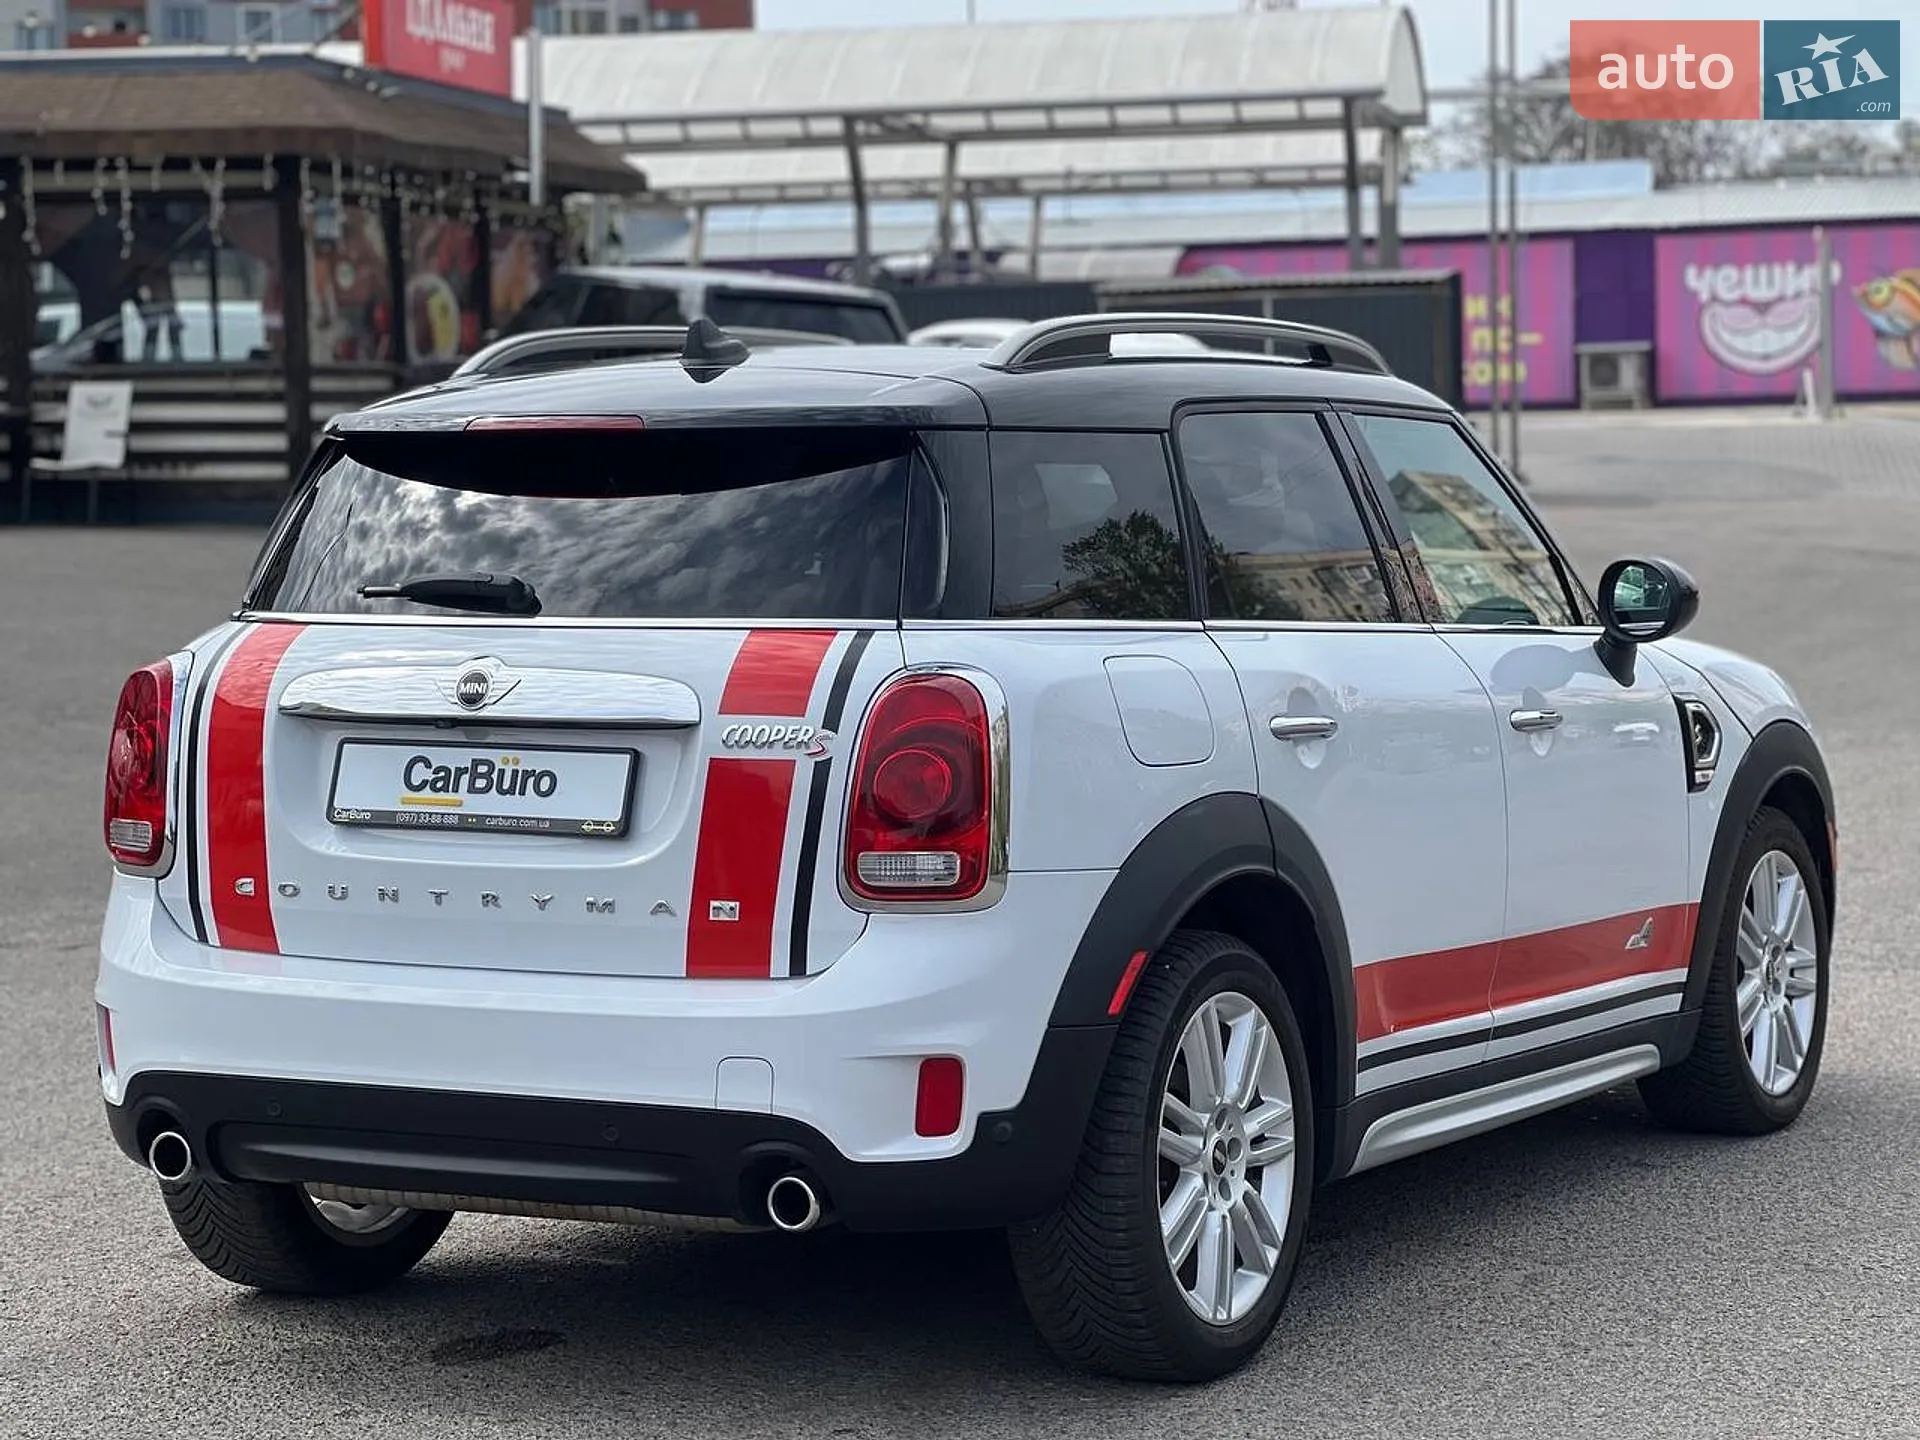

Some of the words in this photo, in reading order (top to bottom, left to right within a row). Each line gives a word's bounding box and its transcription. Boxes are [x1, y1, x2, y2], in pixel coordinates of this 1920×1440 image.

[459, 682, 488, 695] MINI
[721, 724, 815, 750] COOPER
[804, 729, 838, 759] S
[403, 754, 558, 798] CarBüro
[395, 811, 417, 825] (097)
[235, 877, 738, 921] COUNTRYMAN
